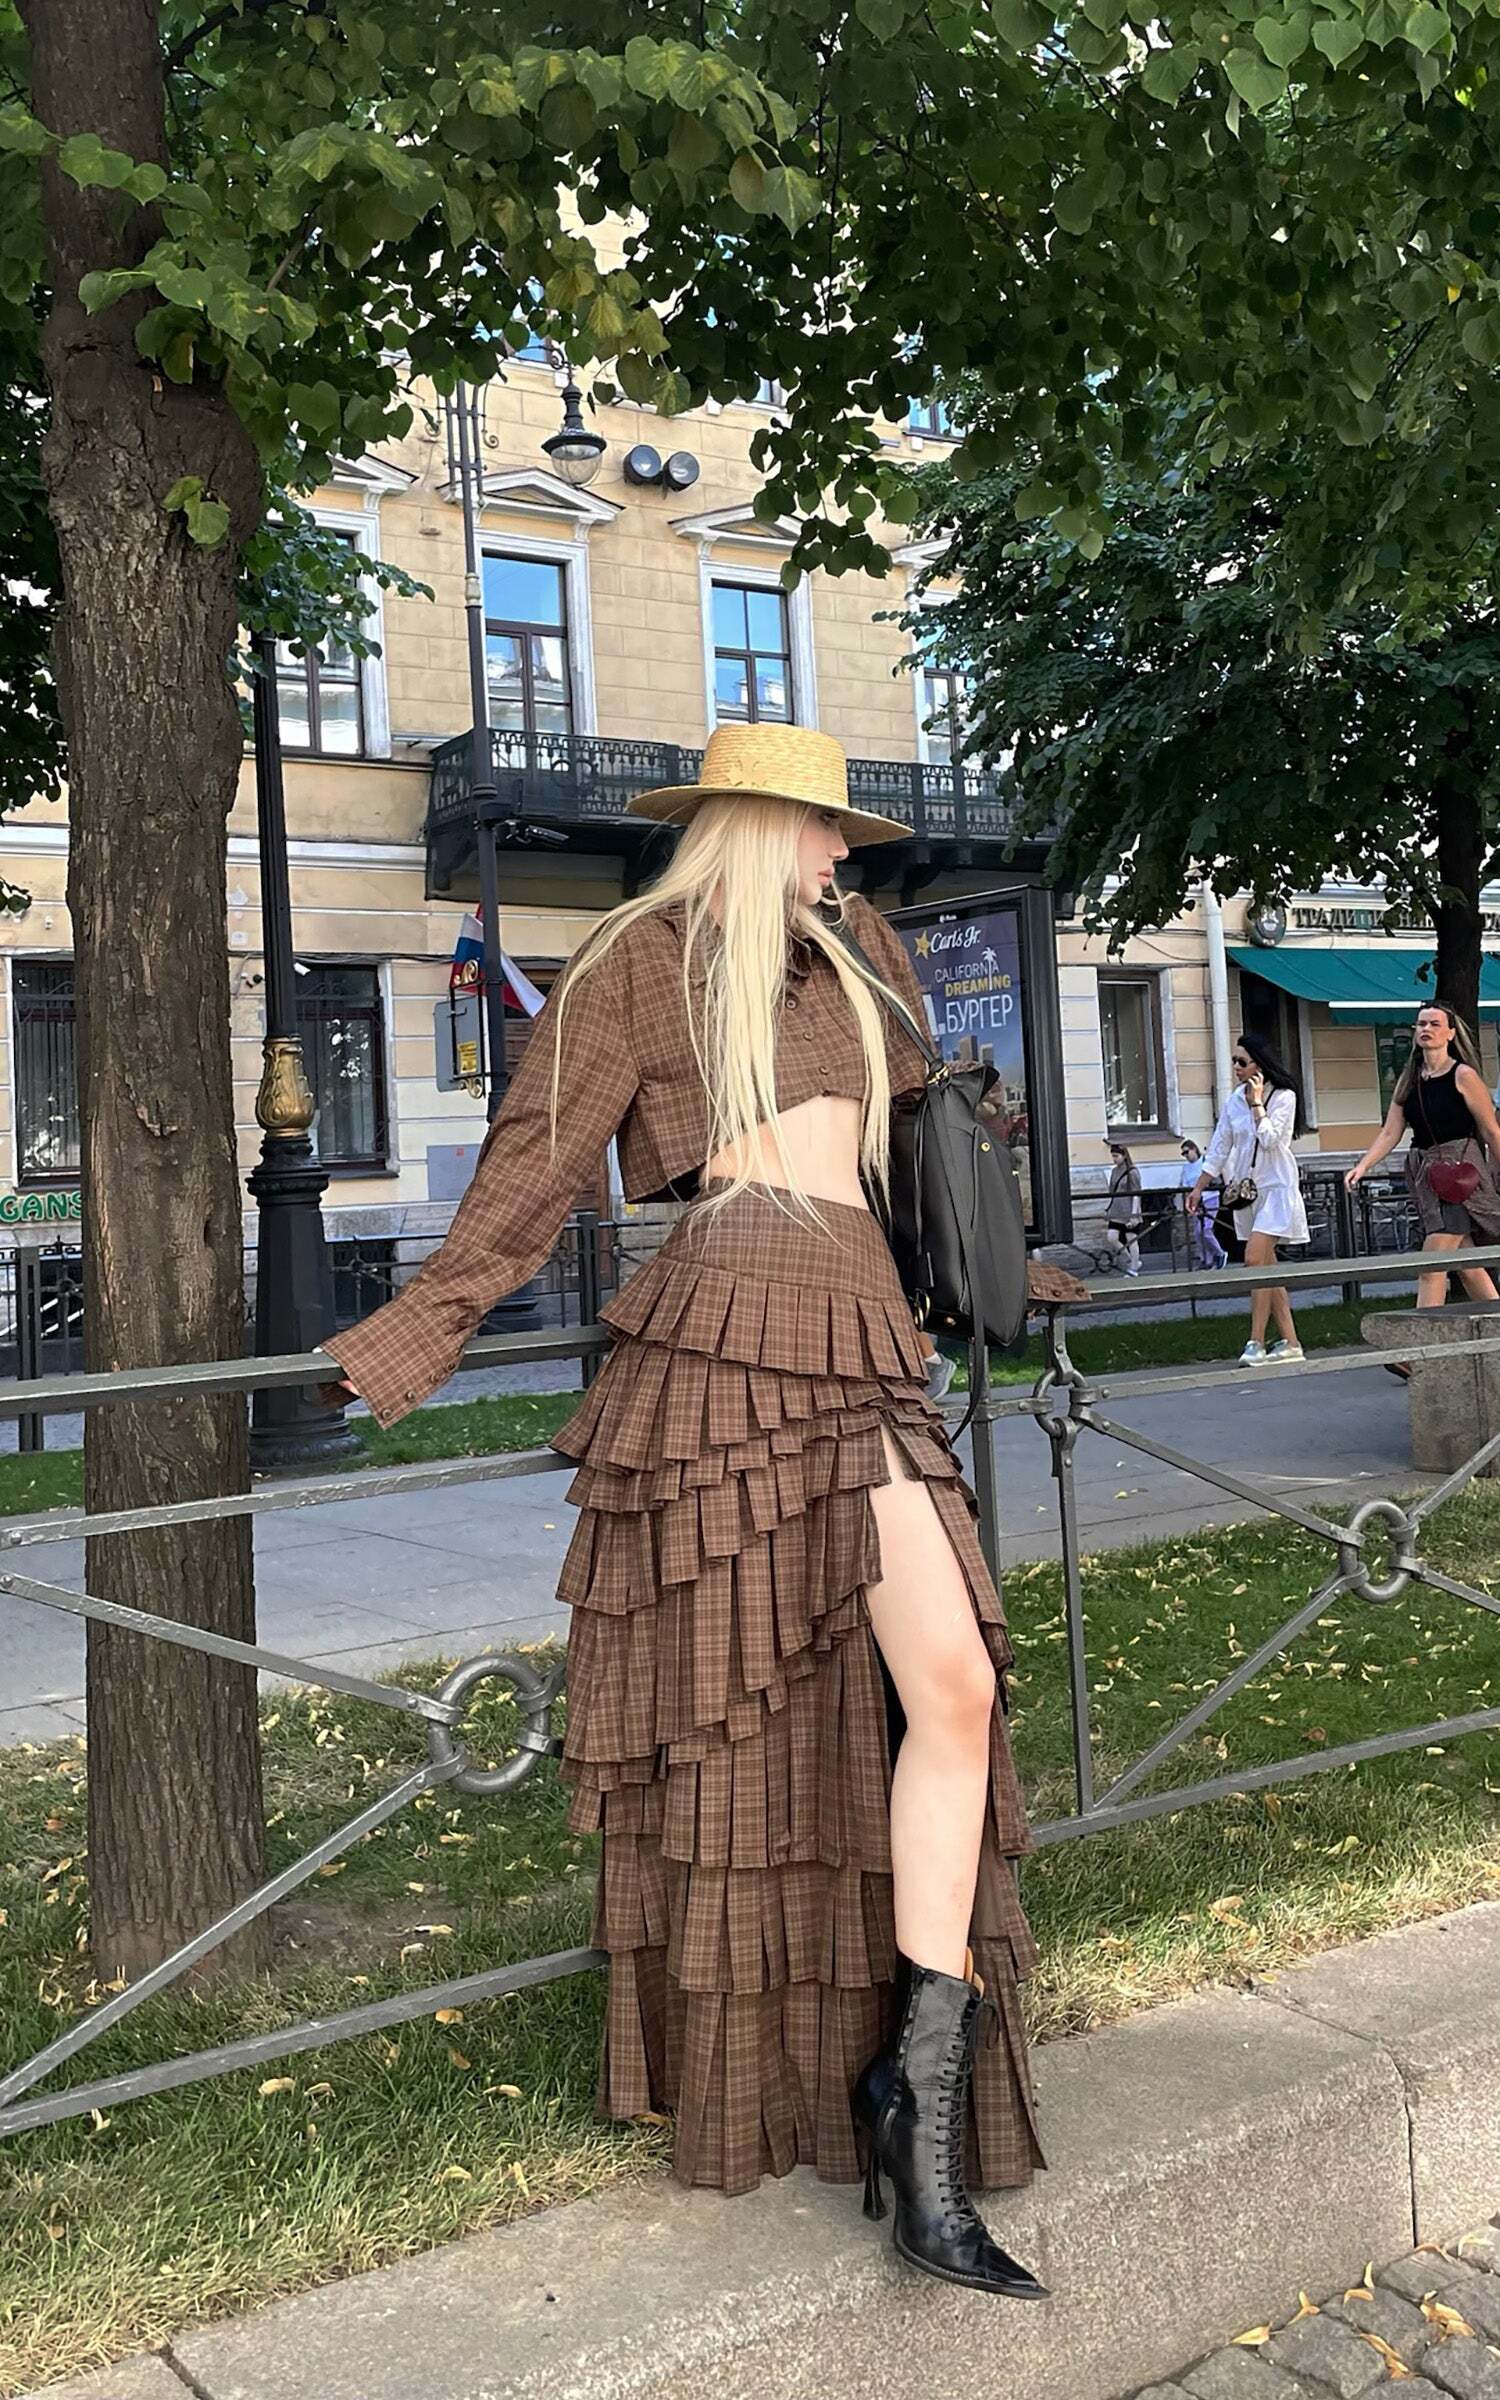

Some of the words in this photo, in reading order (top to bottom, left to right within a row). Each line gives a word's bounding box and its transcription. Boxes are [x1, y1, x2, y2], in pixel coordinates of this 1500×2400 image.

[930, 928, 963, 953] Carl's
[963, 925, 982, 948] Jr.
[934, 960, 1000, 983] CALIFORNIA
[945, 974, 1012, 997] DREAMING
